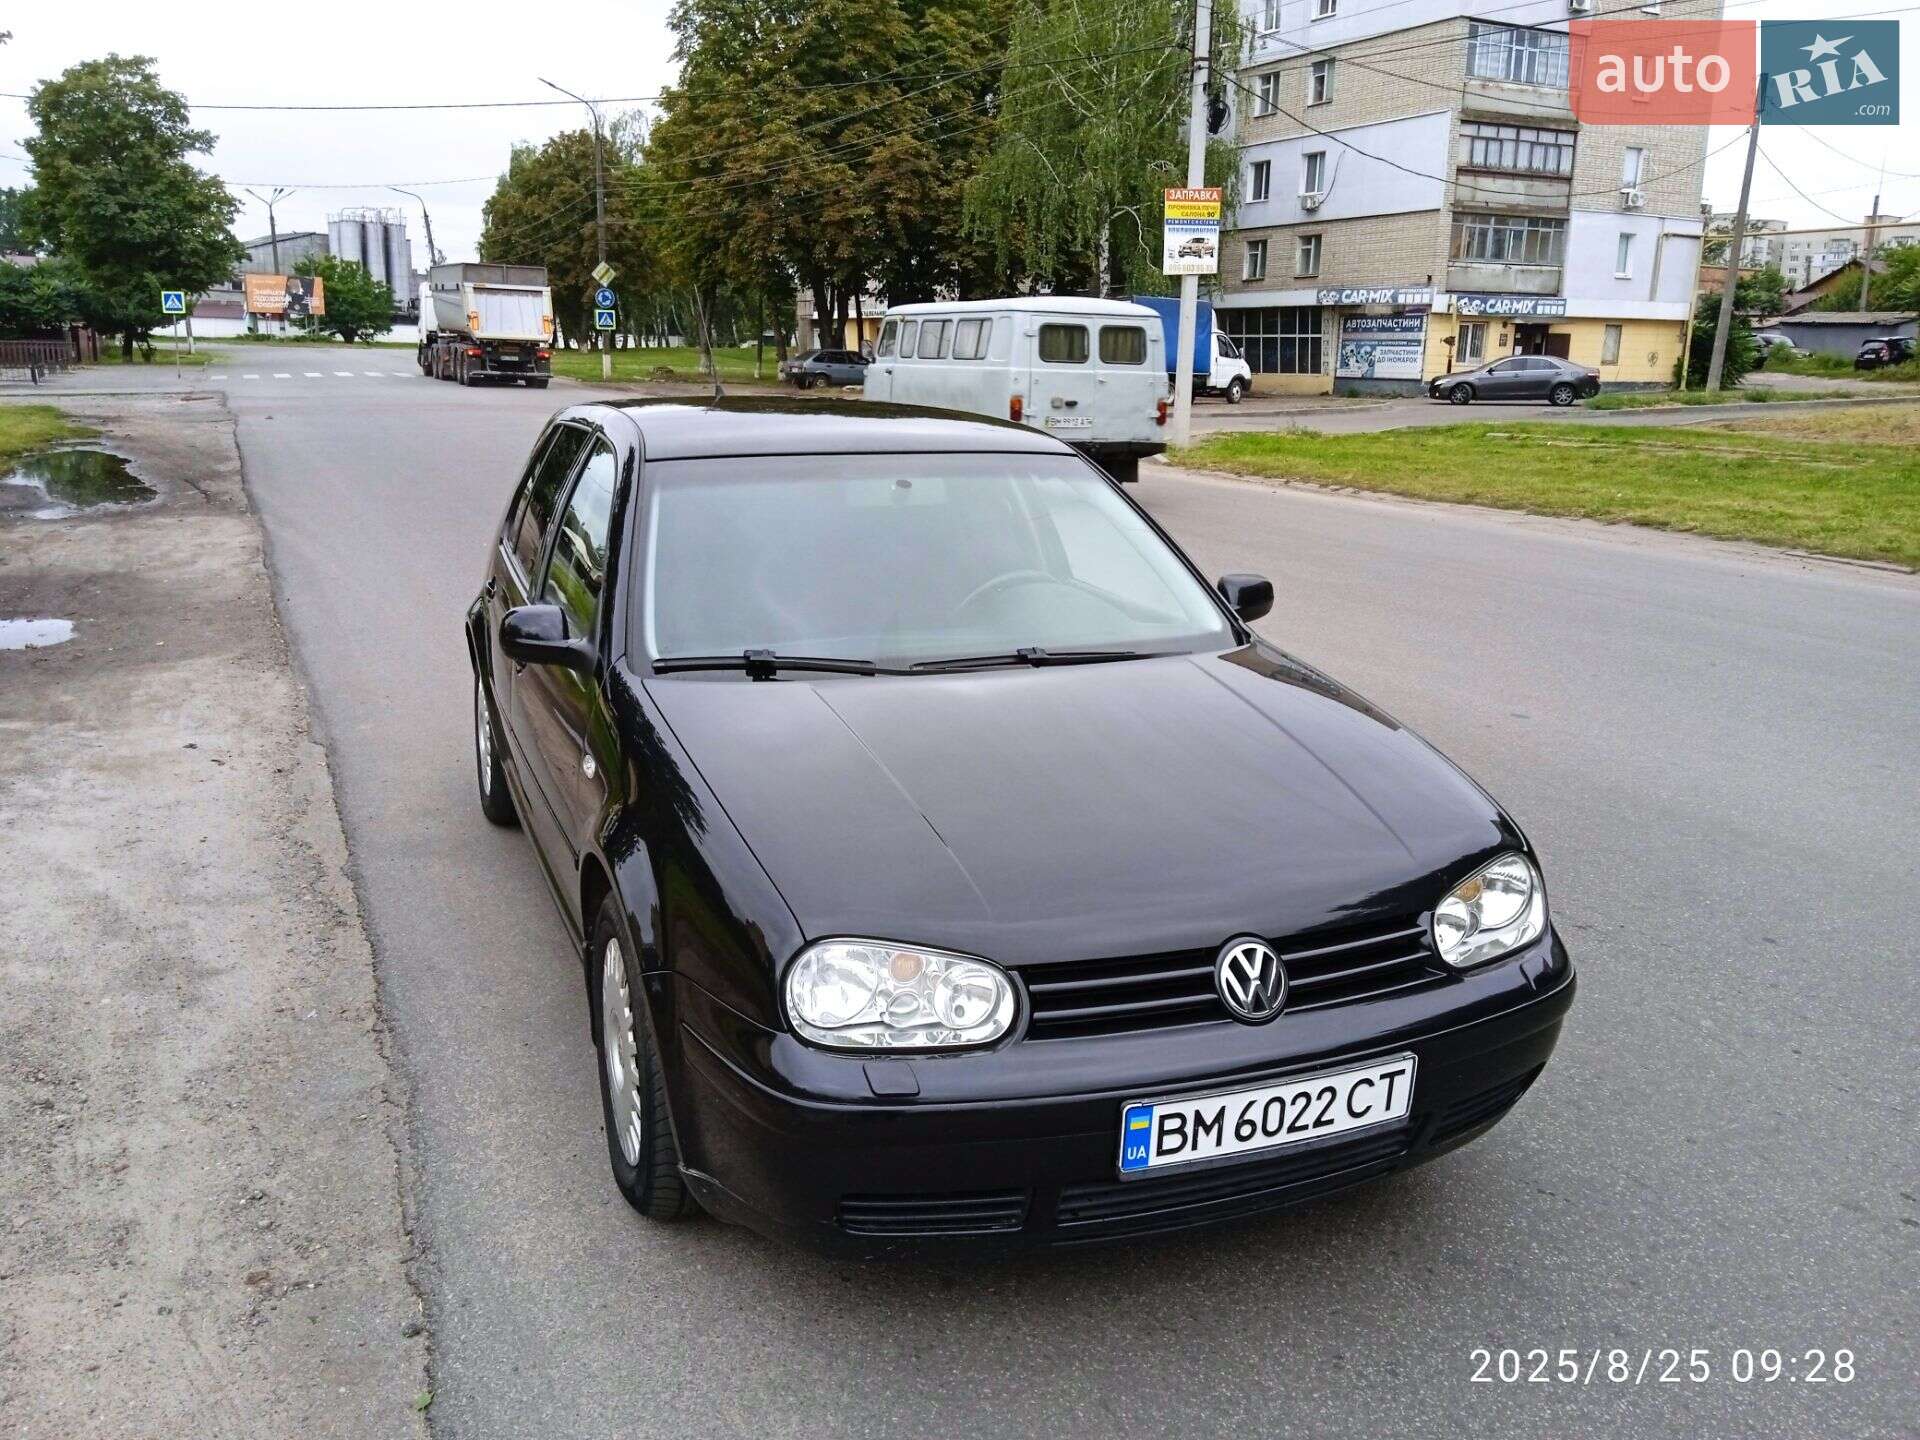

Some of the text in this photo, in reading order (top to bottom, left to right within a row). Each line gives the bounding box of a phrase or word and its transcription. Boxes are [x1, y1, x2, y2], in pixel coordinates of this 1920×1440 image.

[1169, 190, 1219, 200] ЗАПРАВКА
[1346, 318, 1421, 328] АВТОЗАПЧАСТИНИ
[1156, 1069, 1407, 1157] BM 6022 CT
[1127, 1147, 1147, 1160] UA
